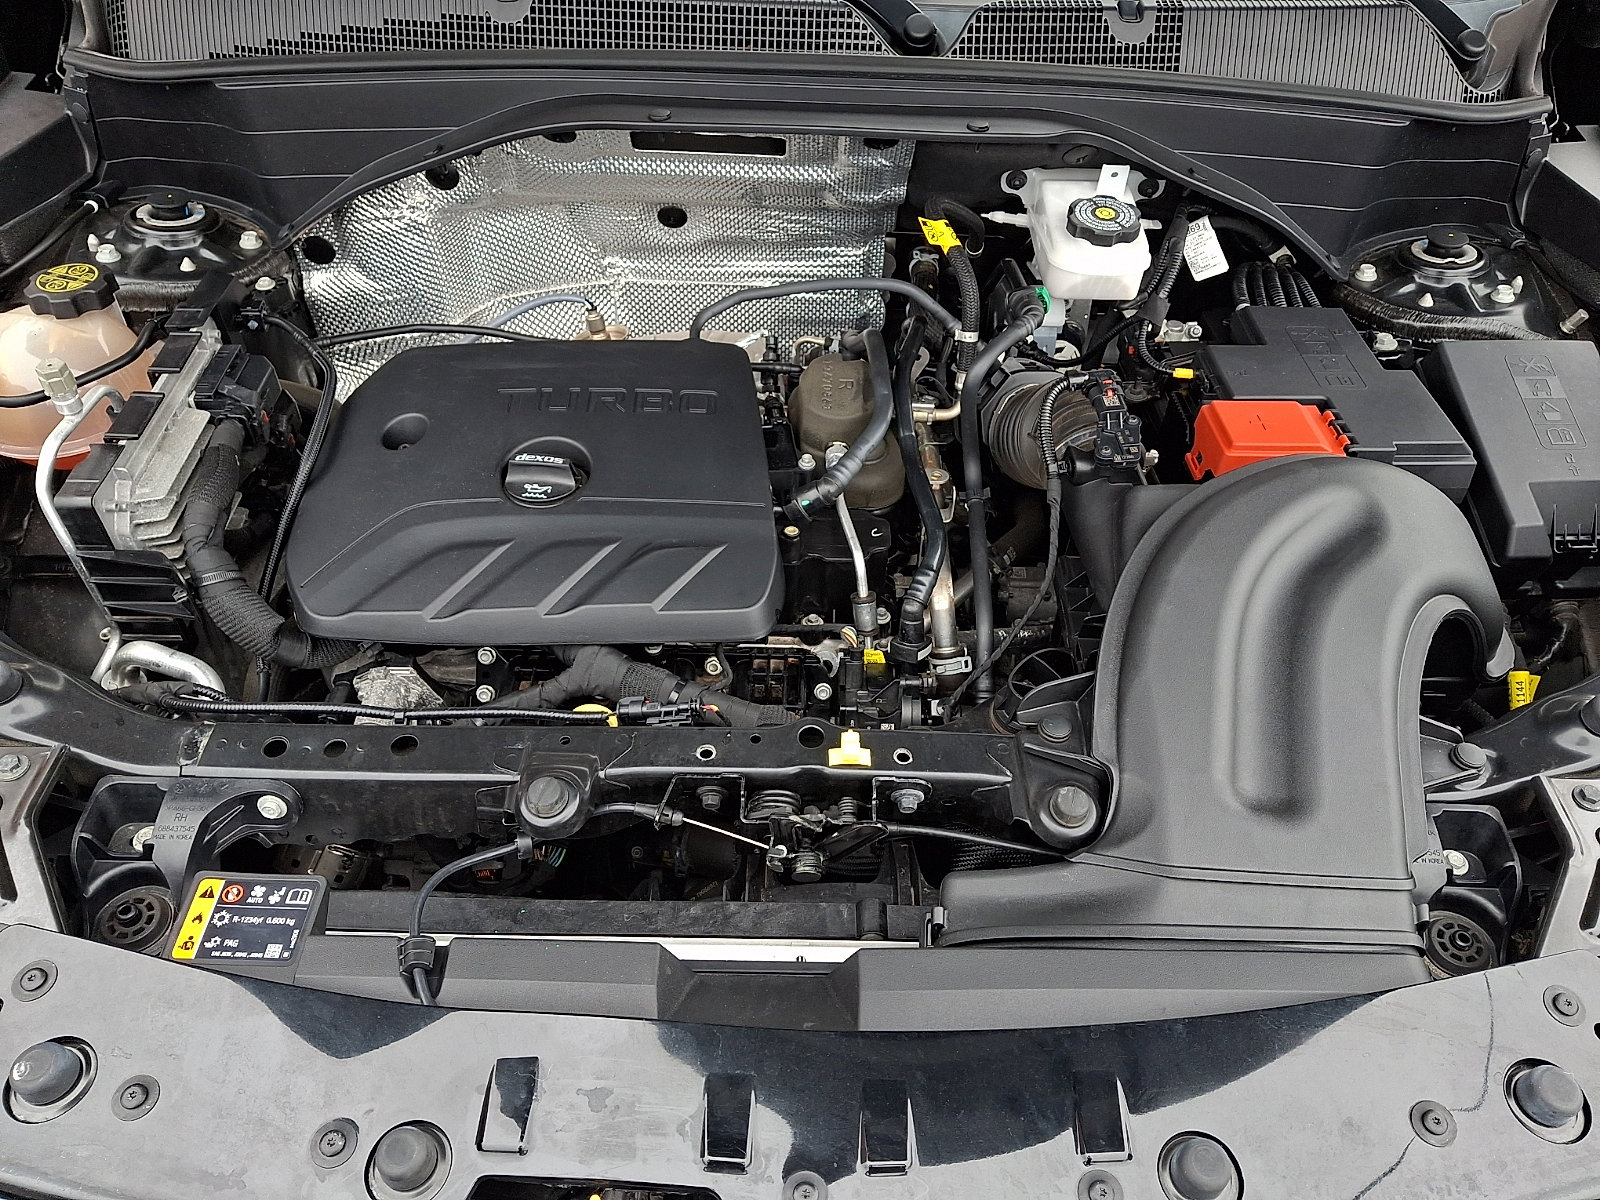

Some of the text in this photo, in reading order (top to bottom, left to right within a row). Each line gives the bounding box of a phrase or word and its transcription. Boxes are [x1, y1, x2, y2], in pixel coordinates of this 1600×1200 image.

[498, 387, 718, 413] TURBO
[514, 453, 564, 464] dexos
[1515, 681, 1525, 703] 1144
[173, 812, 188, 822] RH
[231, 916, 264, 925] R-1234yf
[285, 916, 296, 927] kg
[223, 938, 239, 948] PAG
